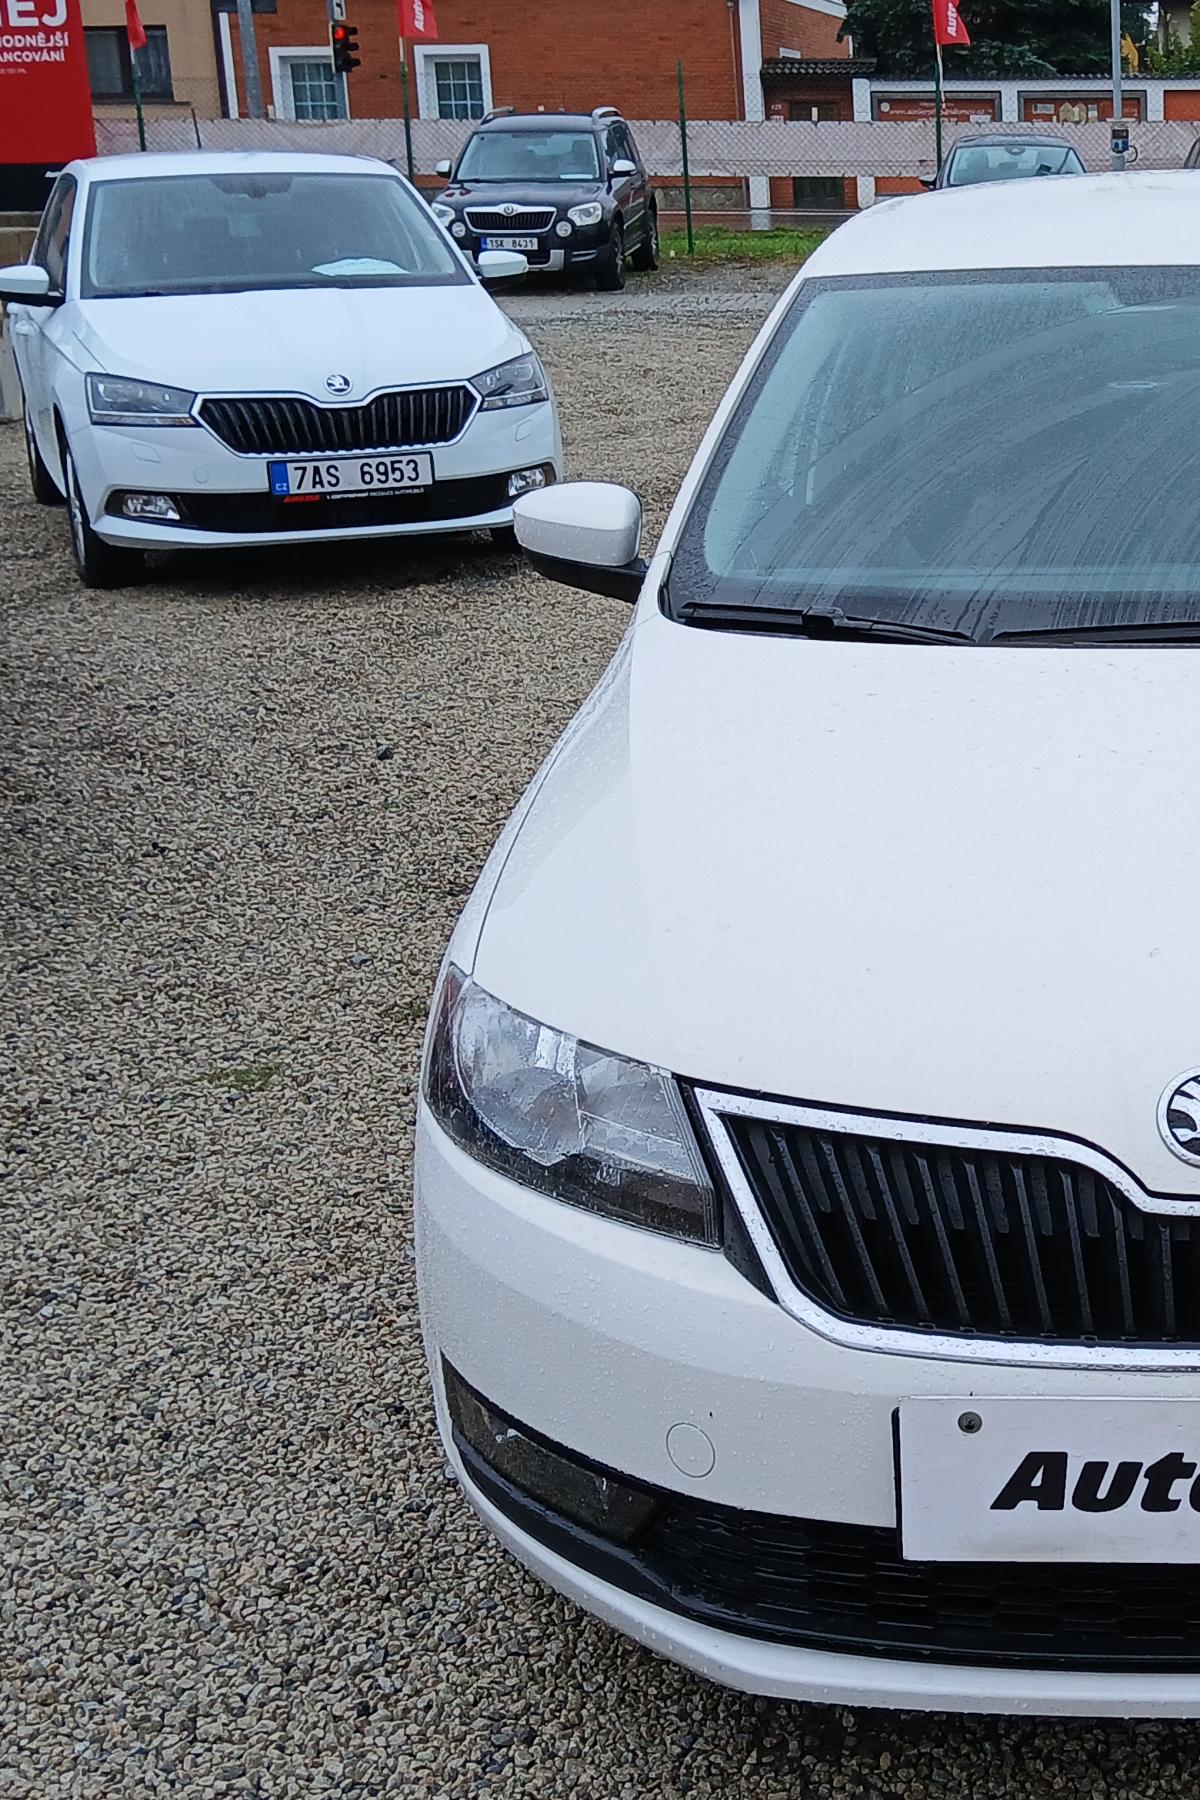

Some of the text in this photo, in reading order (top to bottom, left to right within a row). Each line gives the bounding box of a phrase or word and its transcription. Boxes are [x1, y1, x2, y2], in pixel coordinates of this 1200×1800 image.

[0, 0, 67, 27] EJ
[0, 31, 69, 48] ODNĚJŠÍ
[511, 239, 535, 249] 8431
[275, 459, 420, 491] CZ 7AS 6953
